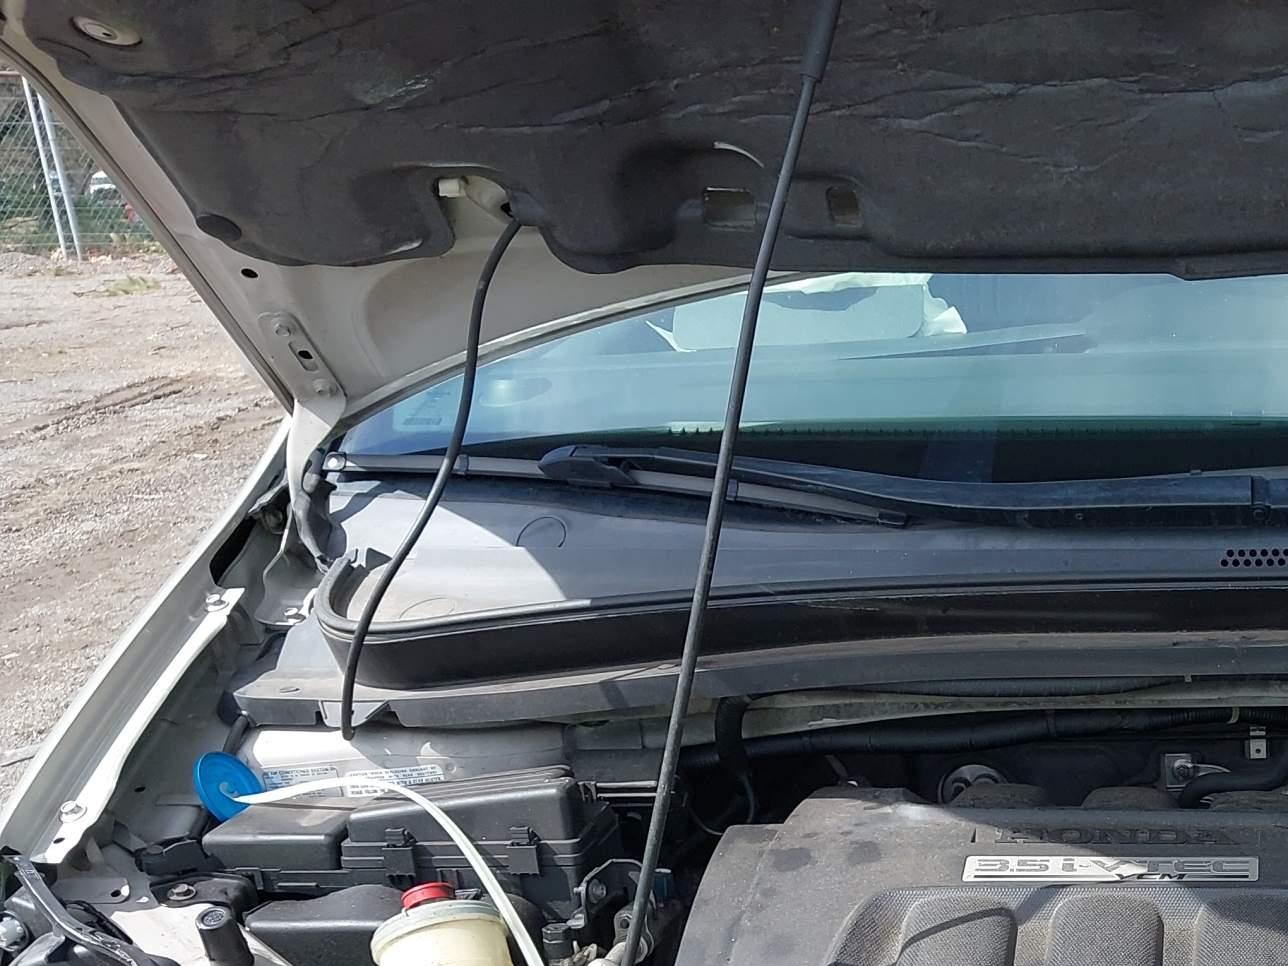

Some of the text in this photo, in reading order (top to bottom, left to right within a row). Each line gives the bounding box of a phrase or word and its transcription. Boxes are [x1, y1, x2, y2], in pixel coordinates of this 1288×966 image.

[994, 828, 1241, 845] HONDA
[974, 858, 1051, 873] 3.5
[1114, 872, 1189, 881] VCM
